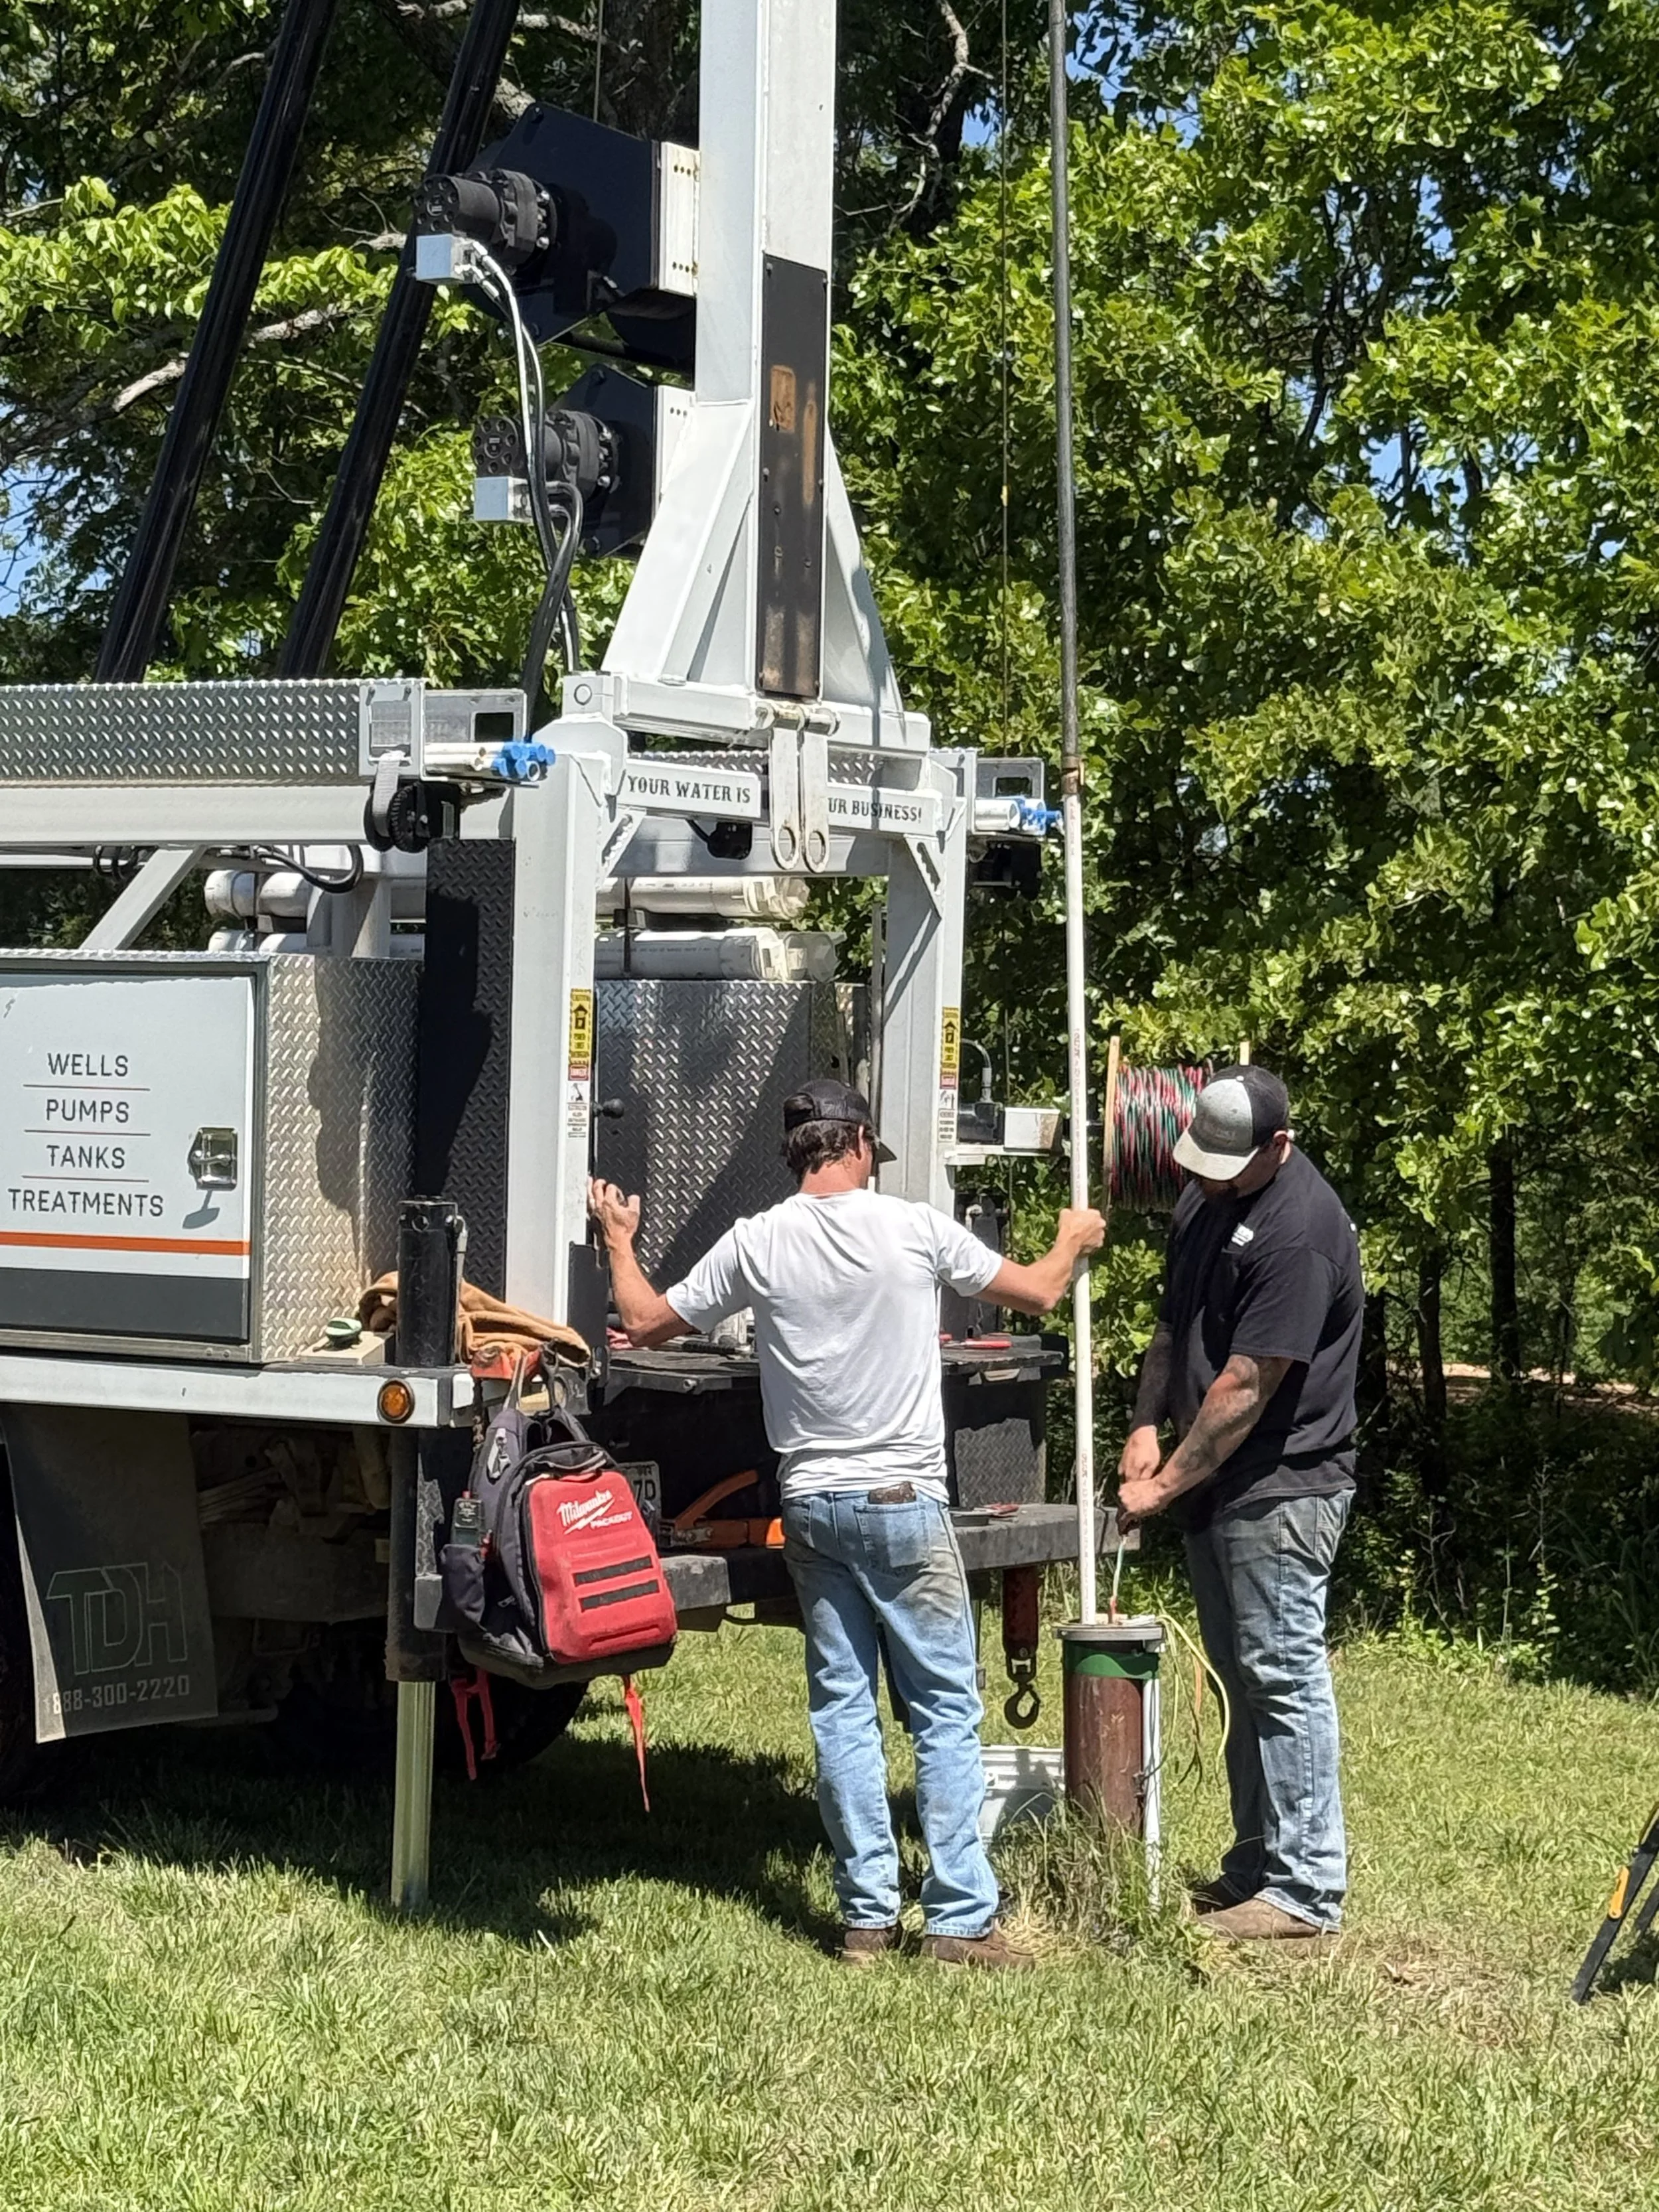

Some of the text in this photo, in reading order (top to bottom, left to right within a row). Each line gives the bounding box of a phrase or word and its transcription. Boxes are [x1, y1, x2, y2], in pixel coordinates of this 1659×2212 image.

[627, 774, 751, 804] YOUR WATER IS
[827, 797, 922, 824] UR BUSINESS!
[47, 1053, 129, 1076] WELLS
[46, 1098, 129, 1123] PUMPS
[46, 1144, 125, 1169] TANKS
[7, 1188, 163, 1217] TREATMENTS
[556, 1489, 614, 1527] Milwaukee
[45, 1561, 188, 1676] TDH
